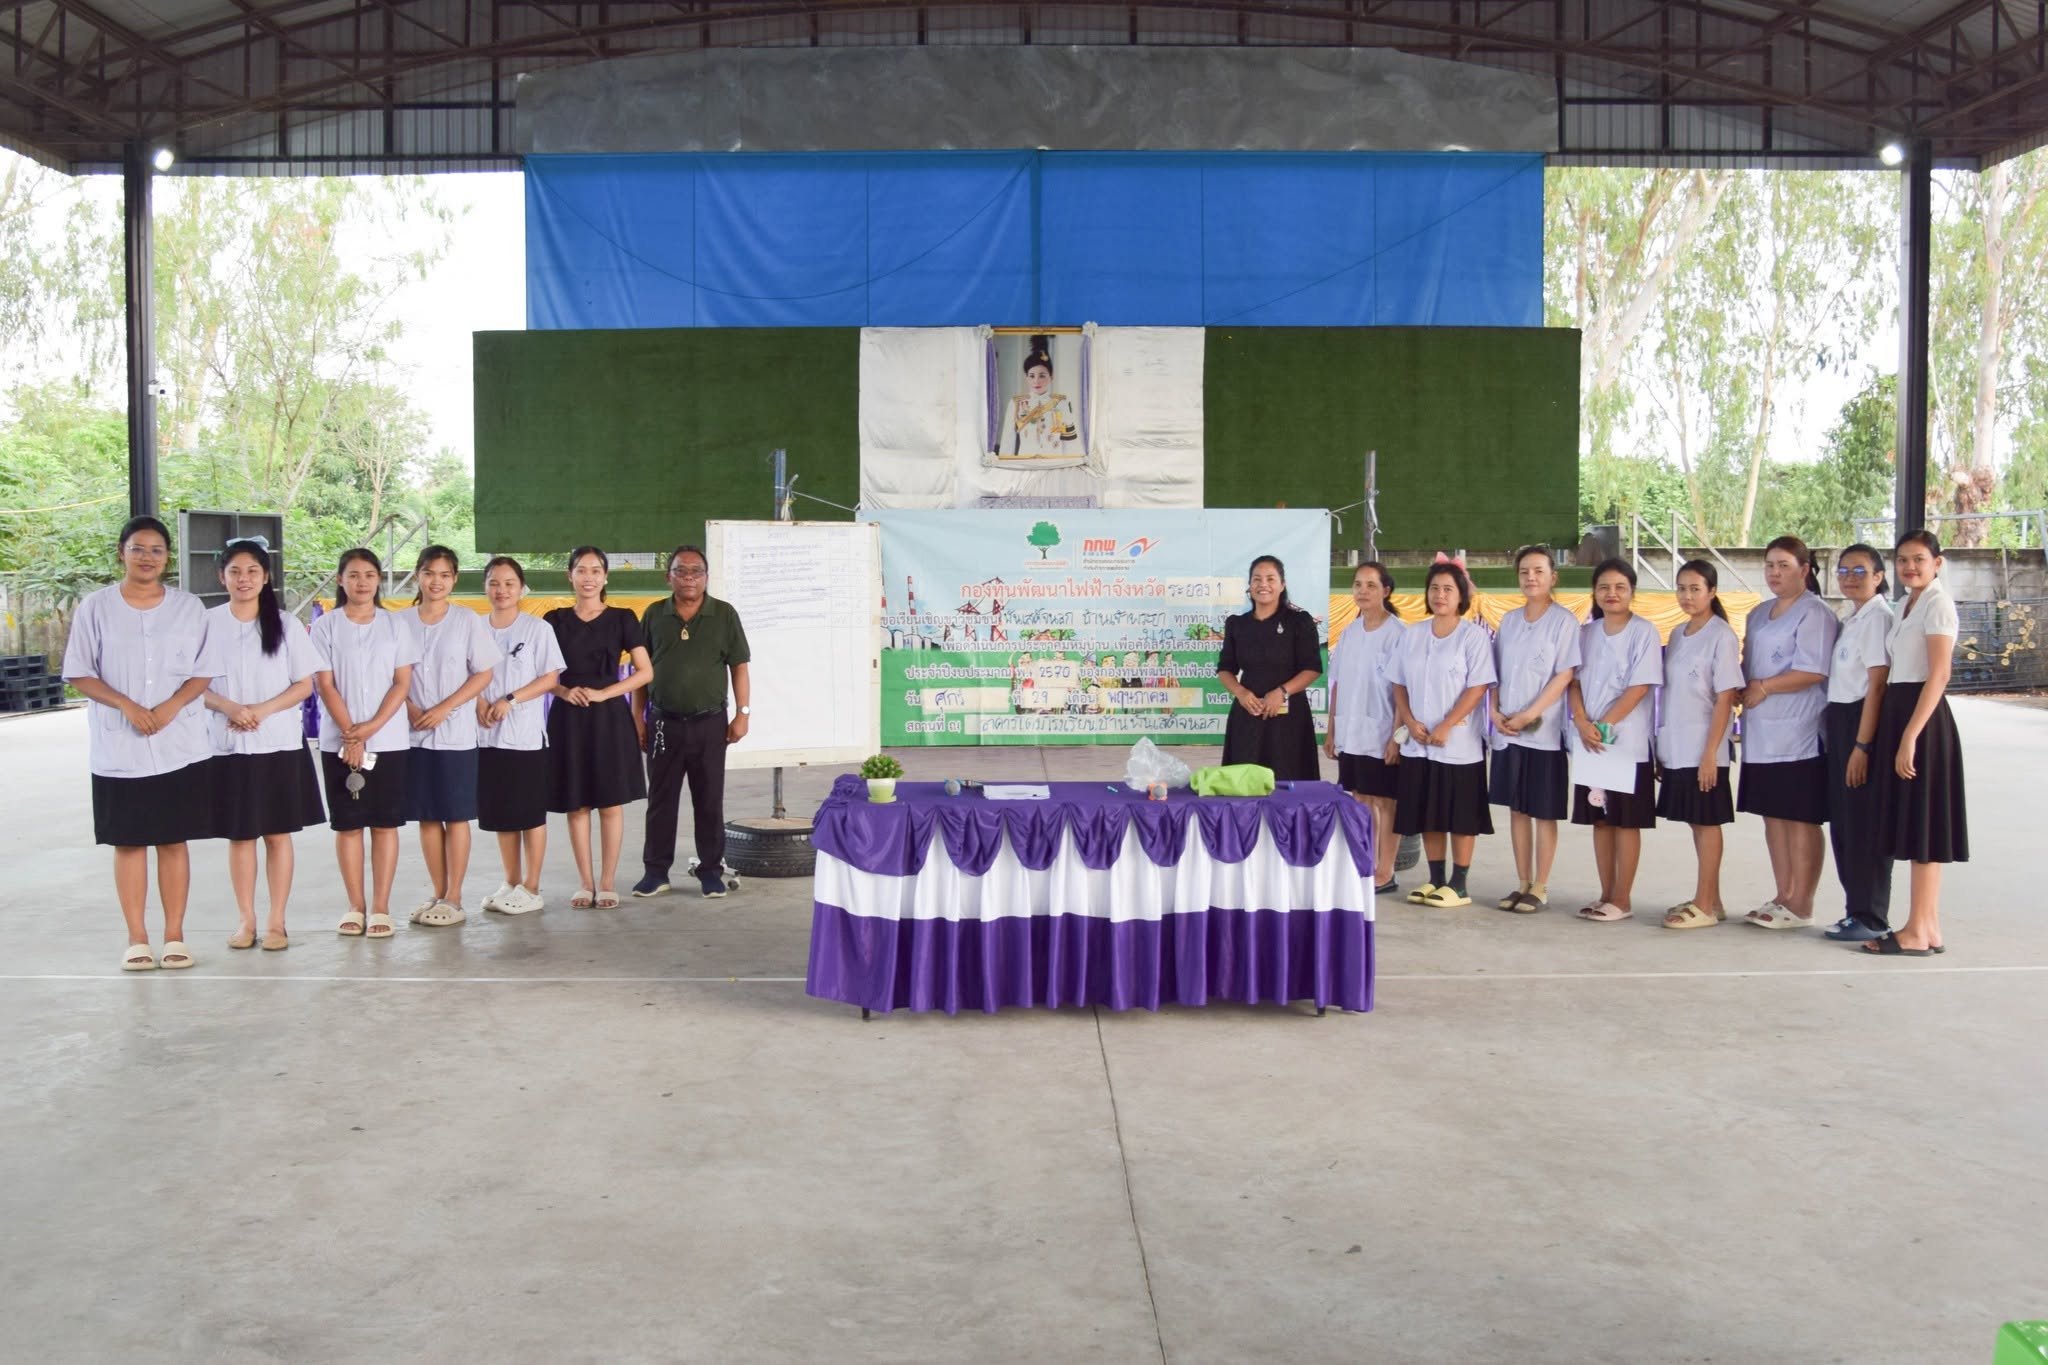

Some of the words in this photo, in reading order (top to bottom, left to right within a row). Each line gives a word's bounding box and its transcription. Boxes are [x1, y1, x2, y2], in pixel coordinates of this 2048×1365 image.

[1083, 539, 1116, 552] กกพ
[961, 577, 1166, 602] กองทุนพัฒนาไฟฟ้าจังหวัด
[1216, 582, 1222, 597] 1
[1039, 665, 1071, 679] 2570
[1031, 690, 1049, 704] 29
[1207, 692, 1232, 704] พ.ศ.
